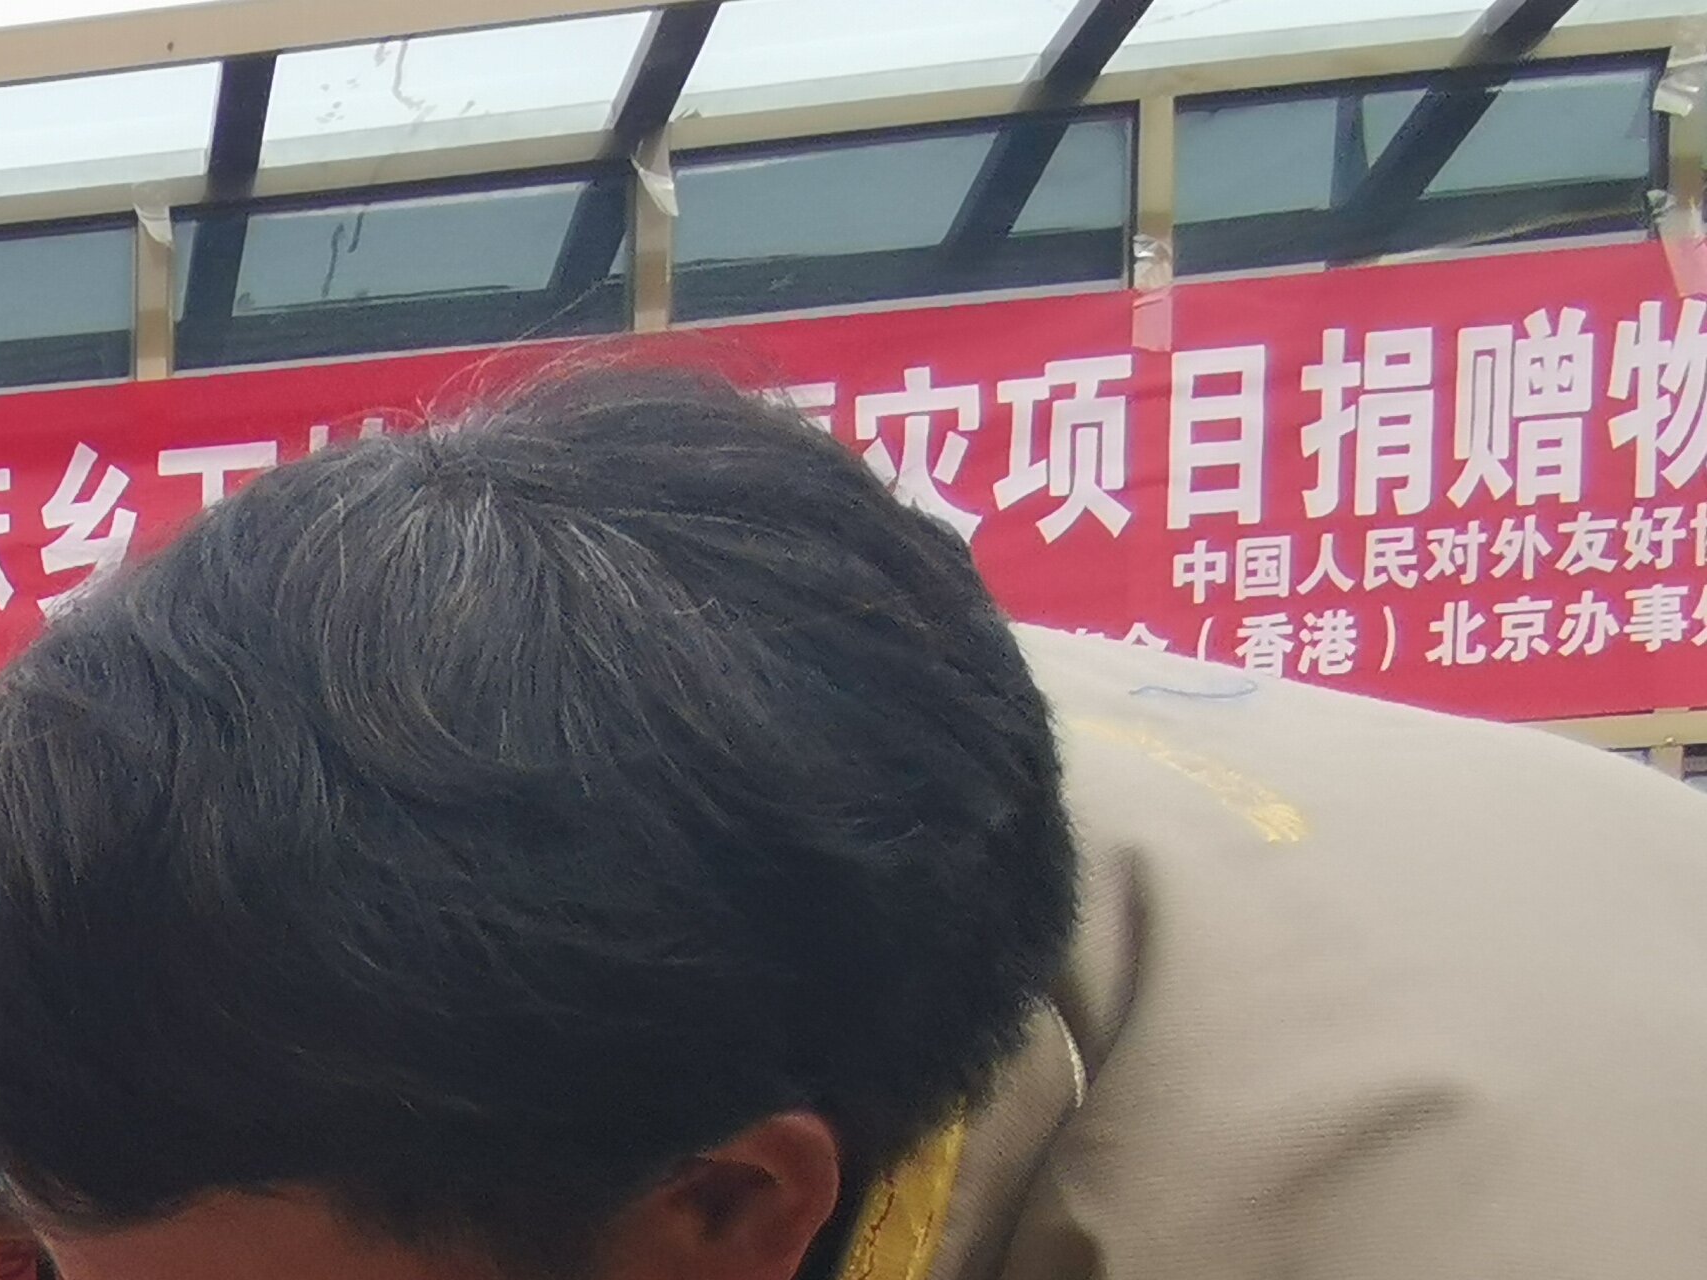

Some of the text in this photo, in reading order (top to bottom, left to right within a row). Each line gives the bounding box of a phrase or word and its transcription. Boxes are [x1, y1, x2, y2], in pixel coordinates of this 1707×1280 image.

[737, 298, 1707, 544] 灾项目捐赠物
[1074, 583, 1707, 679] （香港）北京办事
